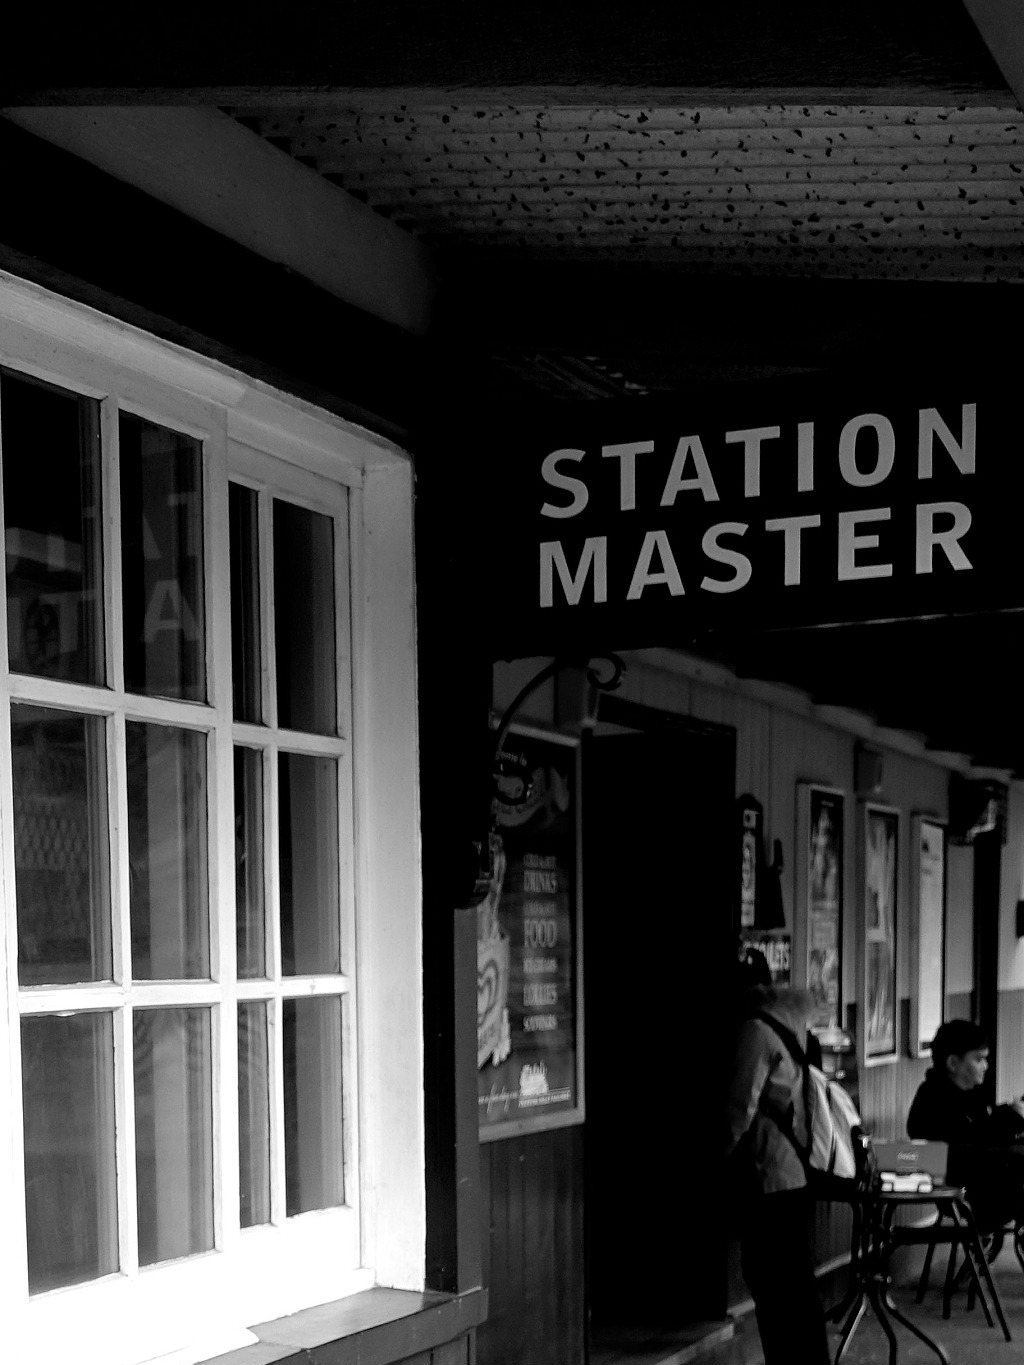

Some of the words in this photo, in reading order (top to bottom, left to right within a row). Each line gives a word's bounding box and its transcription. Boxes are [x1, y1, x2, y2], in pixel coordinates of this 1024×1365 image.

[539, 403, 976, 519] STATION
[539, 501, 974, 608] MASTER
[524, 918, 558, 948] FOOD
